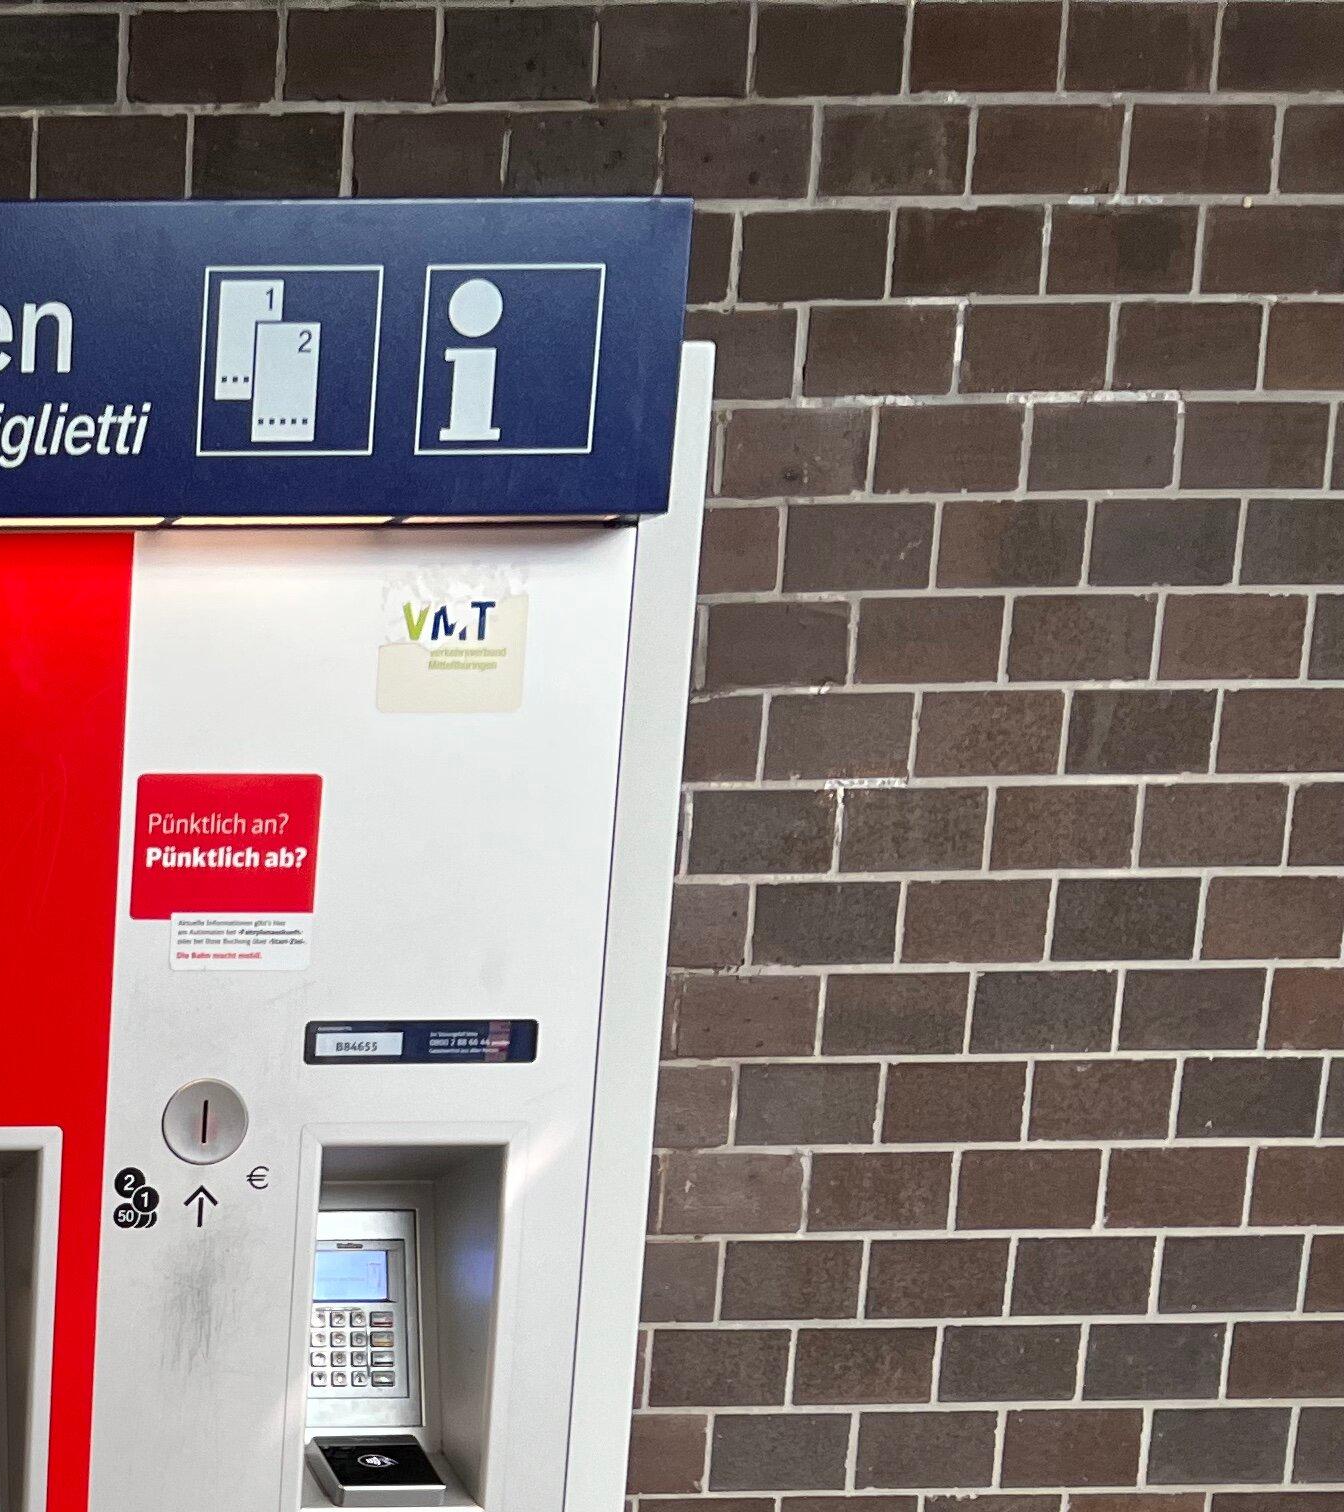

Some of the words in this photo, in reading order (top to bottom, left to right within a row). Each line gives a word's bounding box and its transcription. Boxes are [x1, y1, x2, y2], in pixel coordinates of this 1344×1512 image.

[265, 289, 276, 311] 1
[297, 330, 312, 354] 2
[148, 812, 247, 835] Pünktlich
[251, 812, 290, 835] an?
[145, 846, 260, 869] Pünktlich
[264, 846, 308, 869] ab?
[124, 1174, 136, 1191] 2
[246, 1166, 269, 1190] €
[141, 1193, 150, 1208] 1
[117, 1209, 135, 1223] 50
